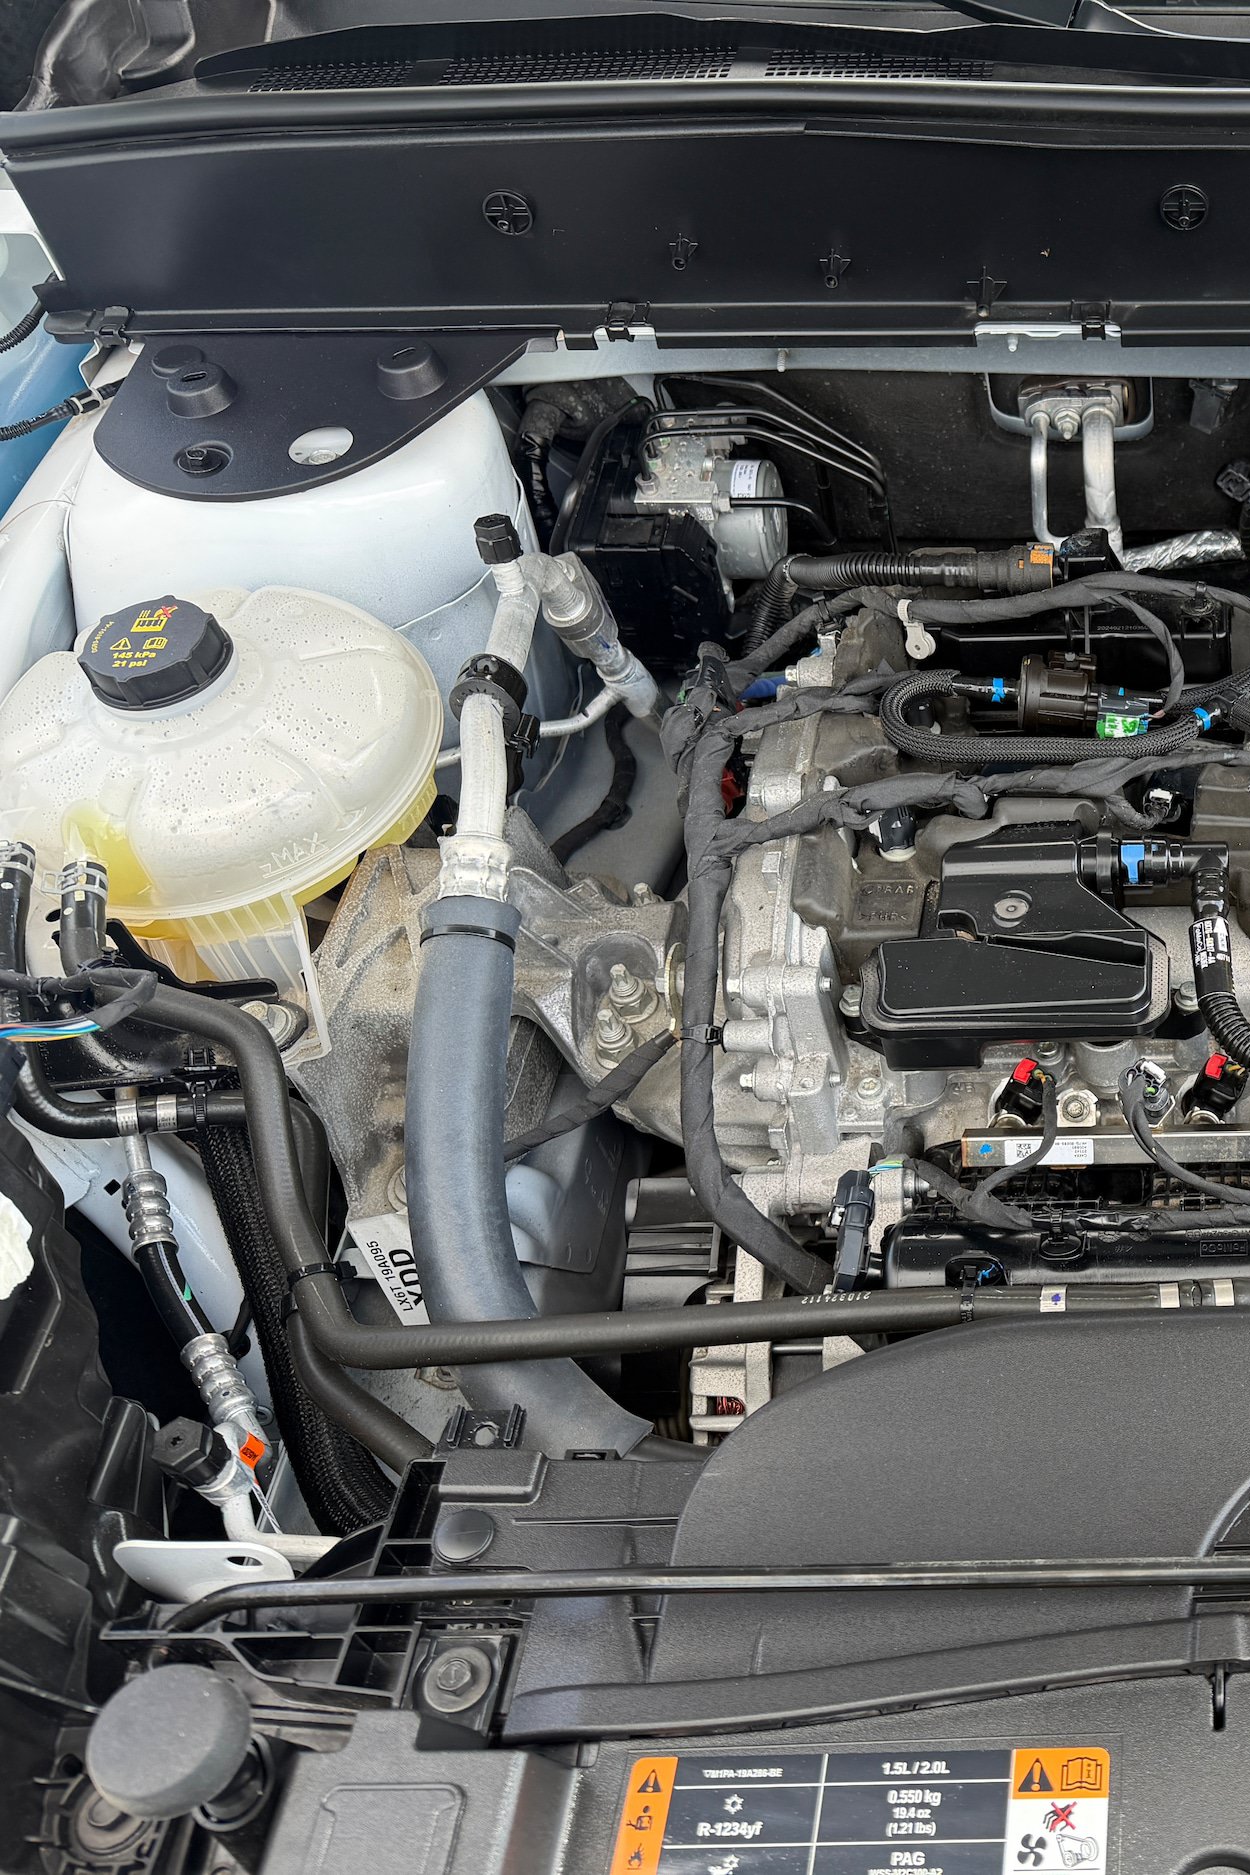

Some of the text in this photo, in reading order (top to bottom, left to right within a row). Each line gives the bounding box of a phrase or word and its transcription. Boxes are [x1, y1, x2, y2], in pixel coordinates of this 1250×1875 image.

[134, 651, 156, 659] kPa
[129, 660, 147, 668] psi
[271, 832, 328, 869] MAX
[366, 1241, 414, 1312] LX6T 19A095
[881, 1762, 912, 1775] 1.5L
[919, 1761, 951, 1774] 2.0L
[887, 1789, 942, 1806] 0.550 kg
[892, 1807, 932, 1819] 19.4 oz
[696, 1821, 764, 1839] R-1234yf
[886, 1821, 937, 1837] (1.21 lbs)
[890, 1852, 926, 1866] PAG
